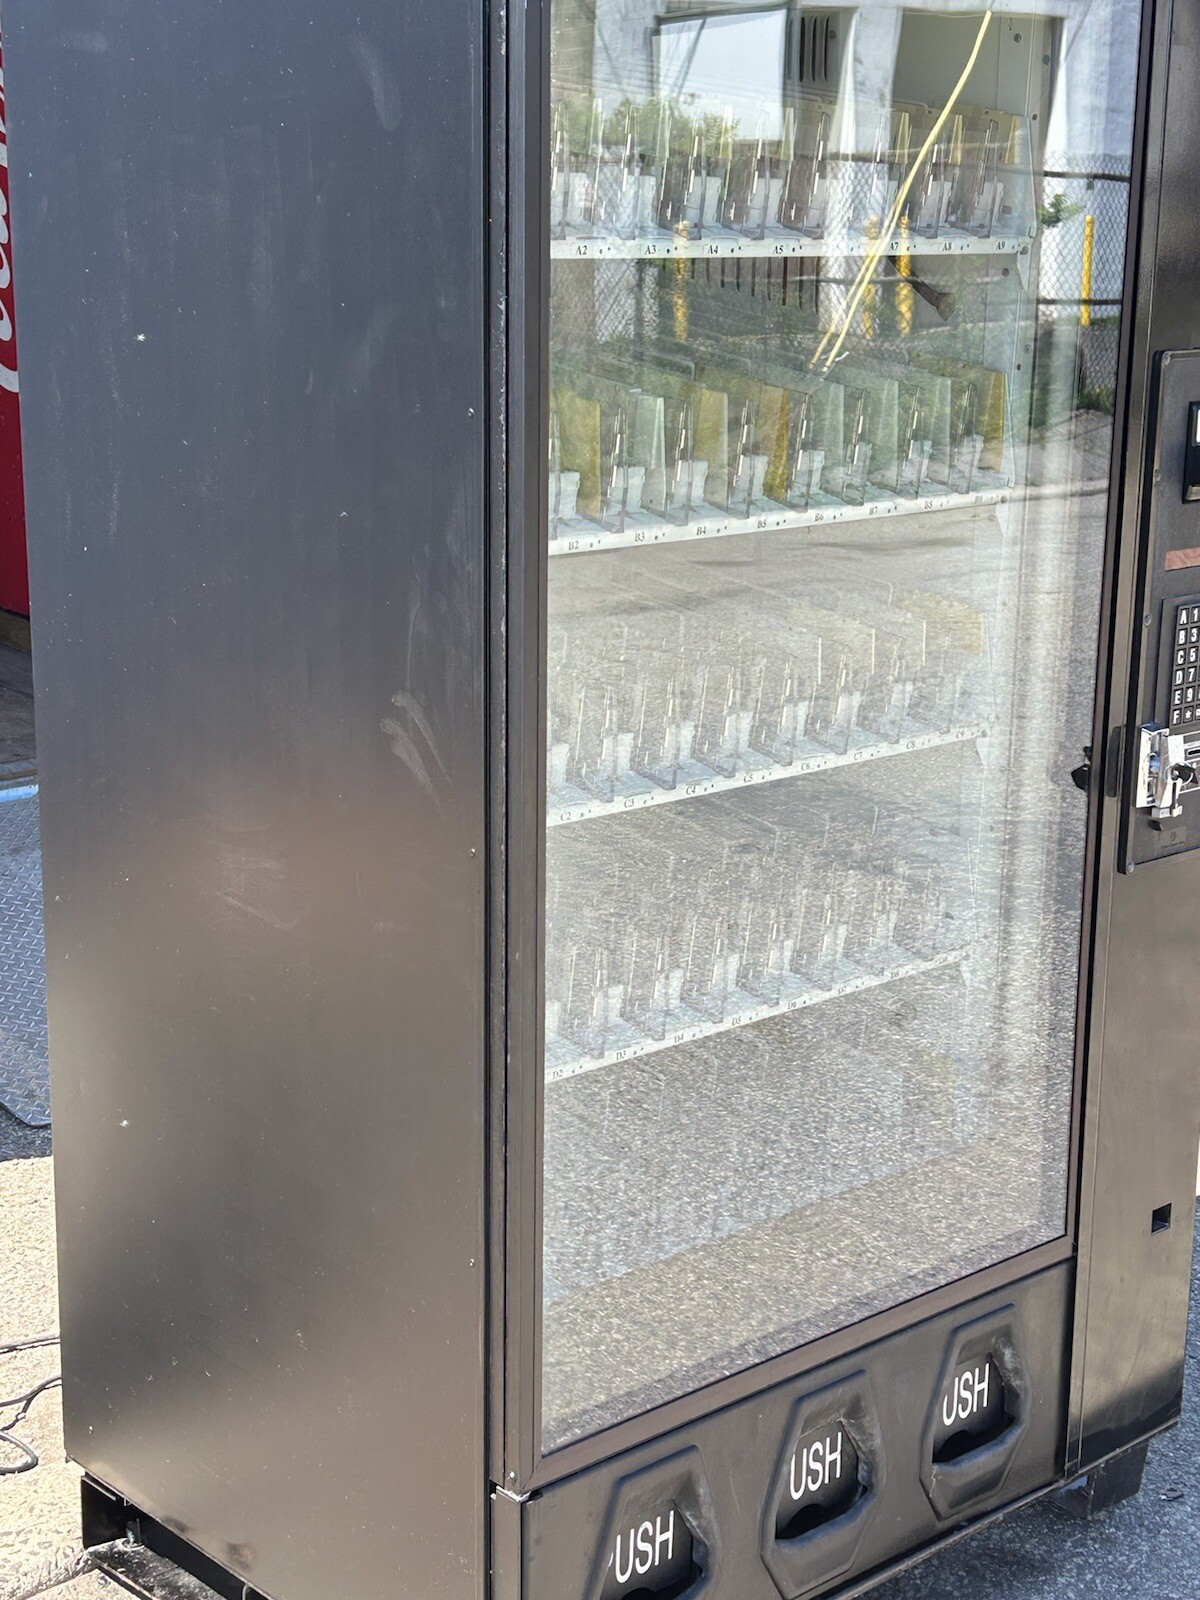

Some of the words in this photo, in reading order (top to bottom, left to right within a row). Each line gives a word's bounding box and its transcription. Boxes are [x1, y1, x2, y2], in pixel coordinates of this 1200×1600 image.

[575, 245, 588, 255] A2
[644, 245, 657, 255] A3
[707, 244, 719, 255] A4
[772, 245, 784, 255] A5
[889, 241, 899, 251] A7
[942, 241, 953, 252] A8
[996, 240, 1006, 251] A9
[567, 540, 579, 550] B2
[634, 532, 645, 542] B3
[696, 526, 707, 536] B4
[757, 519, 767, 529] B5
[1180, 610, 1187, 625] A
[1193, 607, 1199, 621] 1
[1179, 630, 1186, 645] B
[1190, 627, 1198, 643] 3
[1177, 650, 1184, 665] C
[1189, 647, 1196, 663] 5
[1176, 670, 1183, 685] D
[1188, 668, 1195, 683] 7
[1174, 690, 1181, 705] E
[1187, 688, 1193, 703] 9
[1173, 710, 1180, 725] F
[560, 811, 572, 822] C2
[624, 798, 635, 808] C3
[685, 784, 696, 795] C4
[743, 773, 754, 783] C5
[552, 1069, 563, 1080] D2
[616, 1050, 627, 1061] D3
[941, 1362, 990, 1427] USH
[789, 1430, 842, 1501] USH
[607, 1509, 675, 1584] USH
